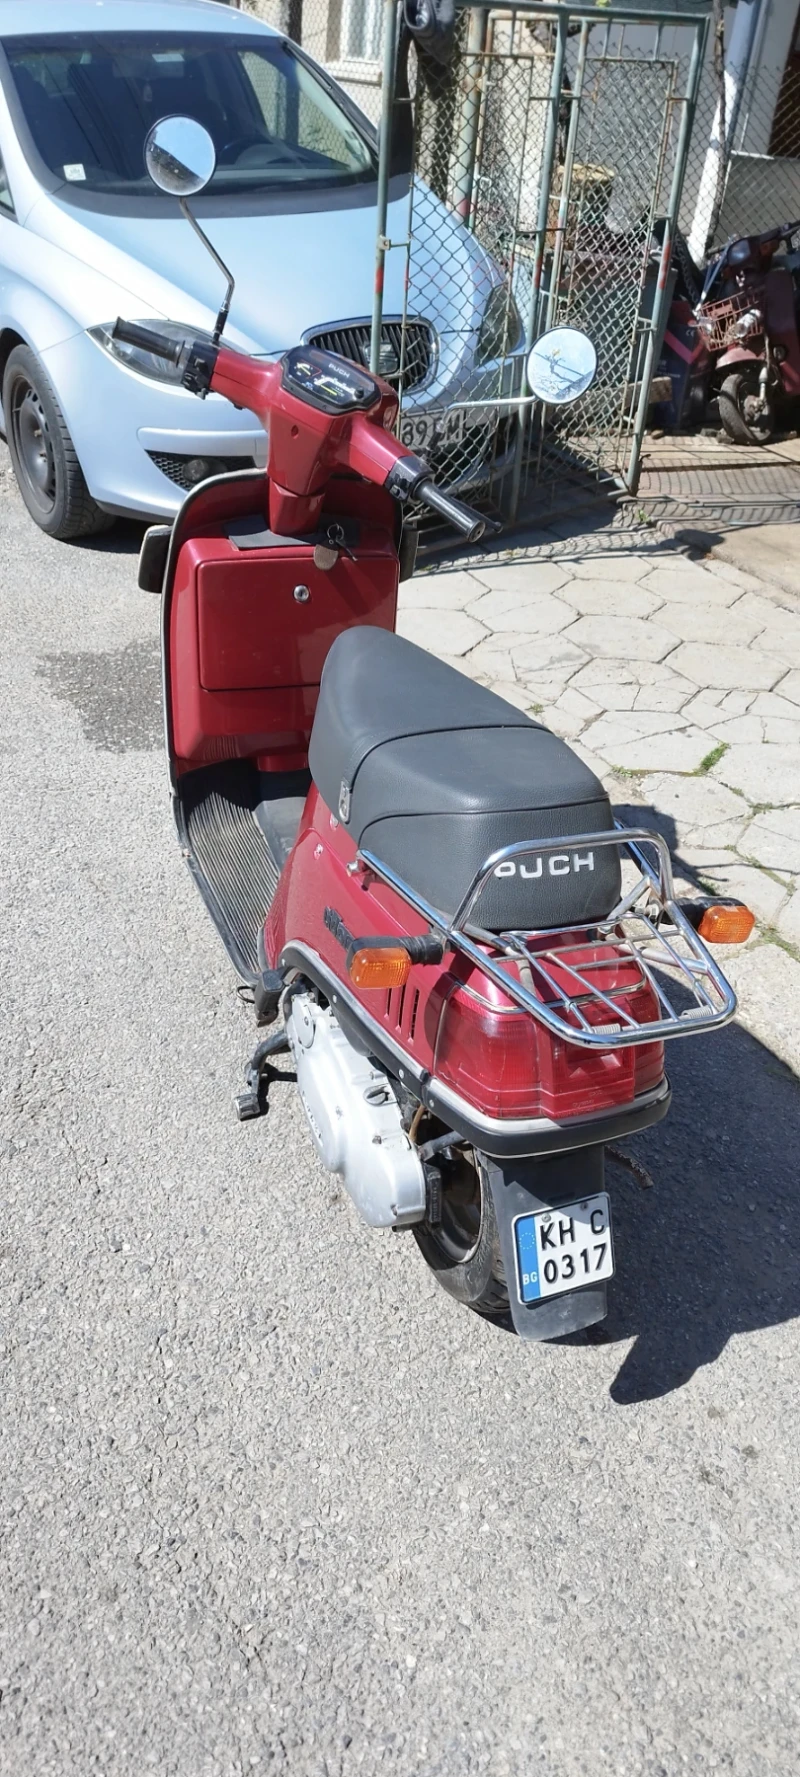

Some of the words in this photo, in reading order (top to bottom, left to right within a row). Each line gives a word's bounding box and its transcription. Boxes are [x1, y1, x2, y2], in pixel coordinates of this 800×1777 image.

[328, 363, 351, 378] PUCH
[540, 1217, 576, 1251] KH
[590, 1209, 606, 1235] C
[543, 1243, 608, 1284] 0317
[522, 1271, 539, 1285] BG
